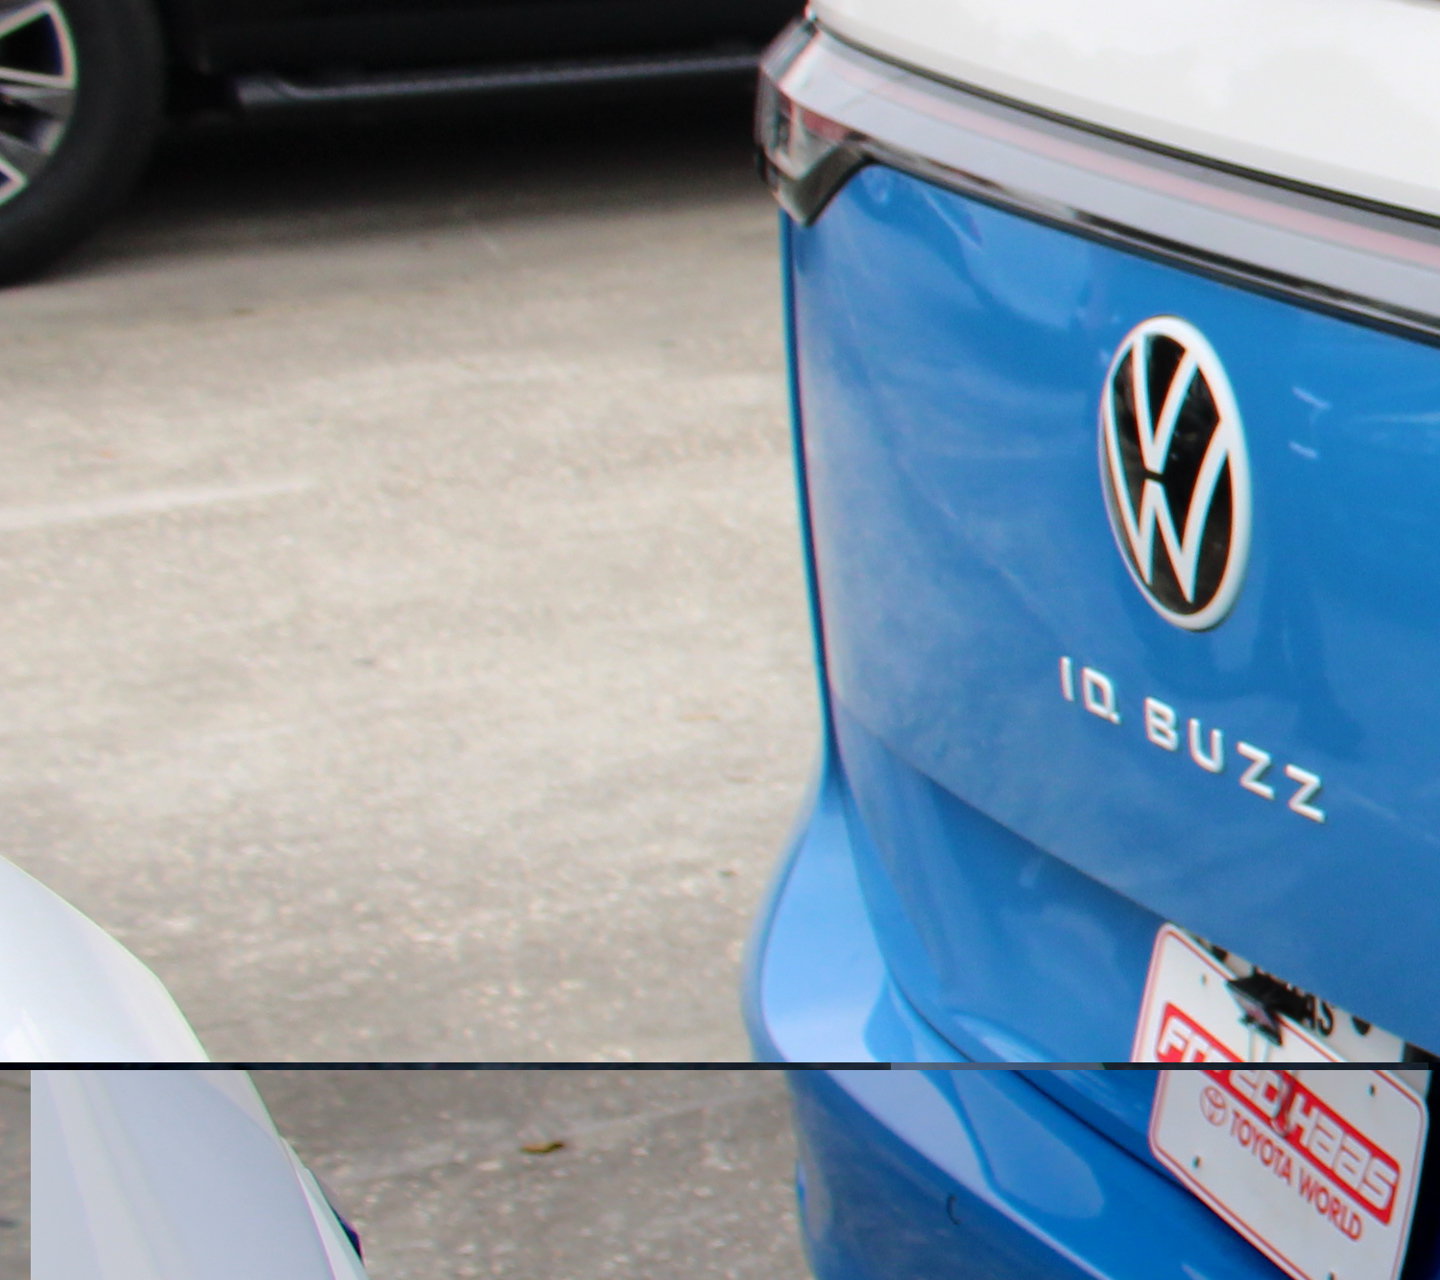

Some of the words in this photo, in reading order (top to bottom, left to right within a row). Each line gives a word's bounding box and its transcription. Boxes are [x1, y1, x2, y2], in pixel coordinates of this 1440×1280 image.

[1144, 696, 1326, 823] BUZZ
[1230, 1109, 1294, 1186] TOYOTA
[1299, 1167, 1362, 1241] WORLD
